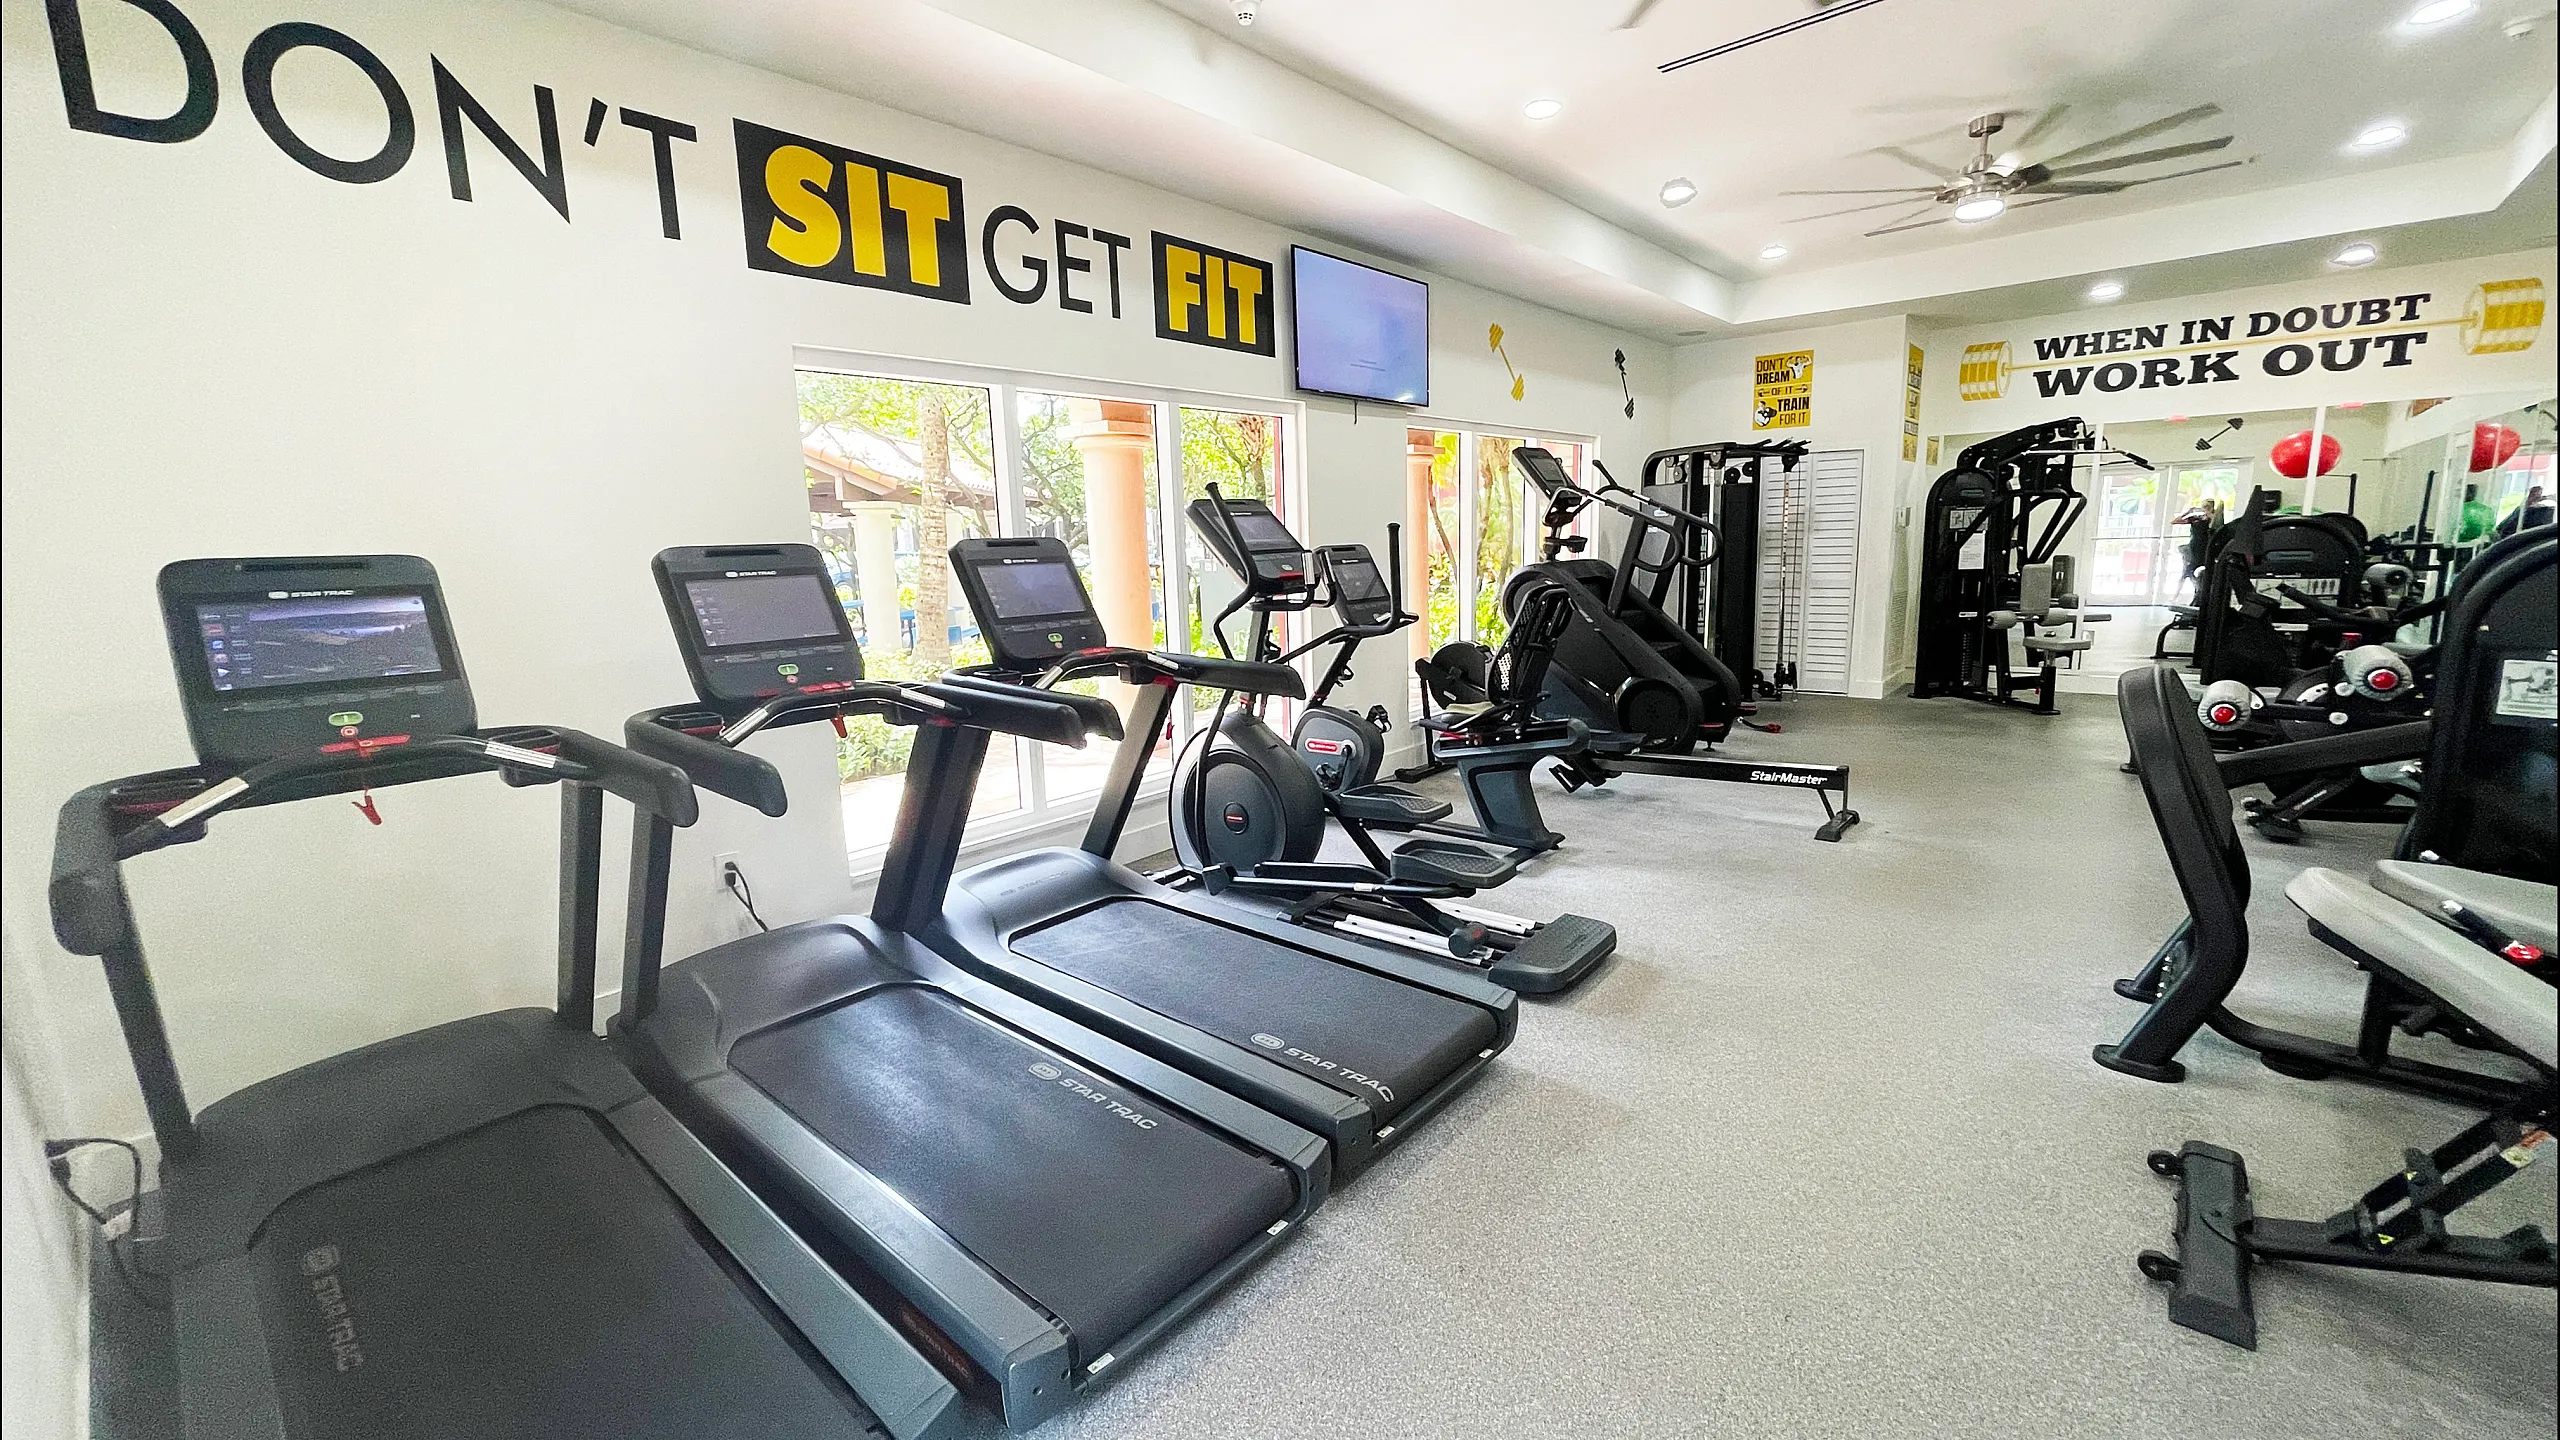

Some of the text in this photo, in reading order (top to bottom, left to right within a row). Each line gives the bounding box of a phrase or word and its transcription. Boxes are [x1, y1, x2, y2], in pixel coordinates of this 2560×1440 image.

[45, 0, 1263, 345] DON'T SIT GET FIT
[2034, 293, 2431, 360] WHEN IN DOUBT
[1756, 358, 1784, 372] DON'T
[2033, 332, 2428, 398] WORK OUT
[1757, 370, 1790, 384] DREAM
[1772, 386, 1794, 396] OF IT
[1778, 397, 1810, 412] TRAIN
[1780, 412, 1806, 425] FOR IT
[322, 589, 354, 597] TRAC
[1750, 770, 1828, 785] StairMaster
[1284, 1047, 1395, 1103] STAR TRAC
[1059, 1078, 1158, 1129] STAR TRAC
